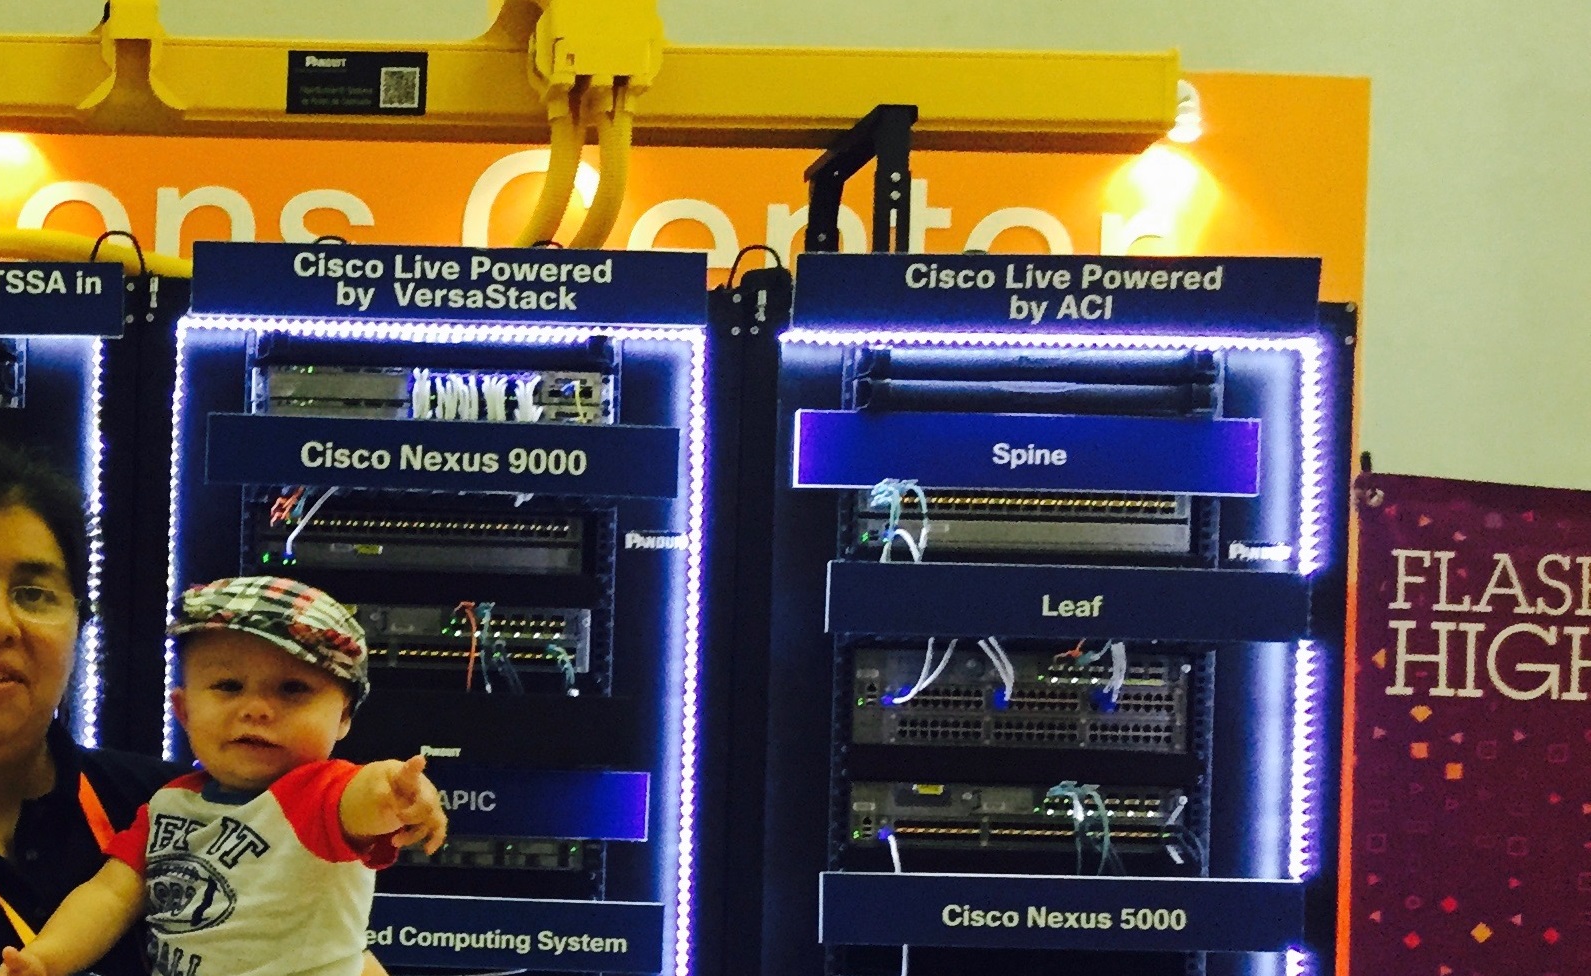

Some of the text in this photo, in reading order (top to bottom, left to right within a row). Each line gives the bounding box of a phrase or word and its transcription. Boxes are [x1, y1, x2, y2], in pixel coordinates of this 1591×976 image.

[293, 251, 613, 285] Cisco Live Powered
[904, 262, 1224, 292] Cisco Live Powered
[75, 270, 103, 296] in
[336, 284, 577, 312] by VersaStack
[1009, 294, 1113, 323] by ACI
[300, 441, 588, 476] Cisco Nexus 9000
[992, 442, 1068, 470] Spine
[1388, 548, 1591, 617] FLAS
[1041, 594, 1104, 618] Leaf
[206, 806, 271, 870] IT
[941, 904, 1187, 931] Cisco Nexus 5000
[398, 926, 531, 955] Computing
[537, 930, 628, 956] System
